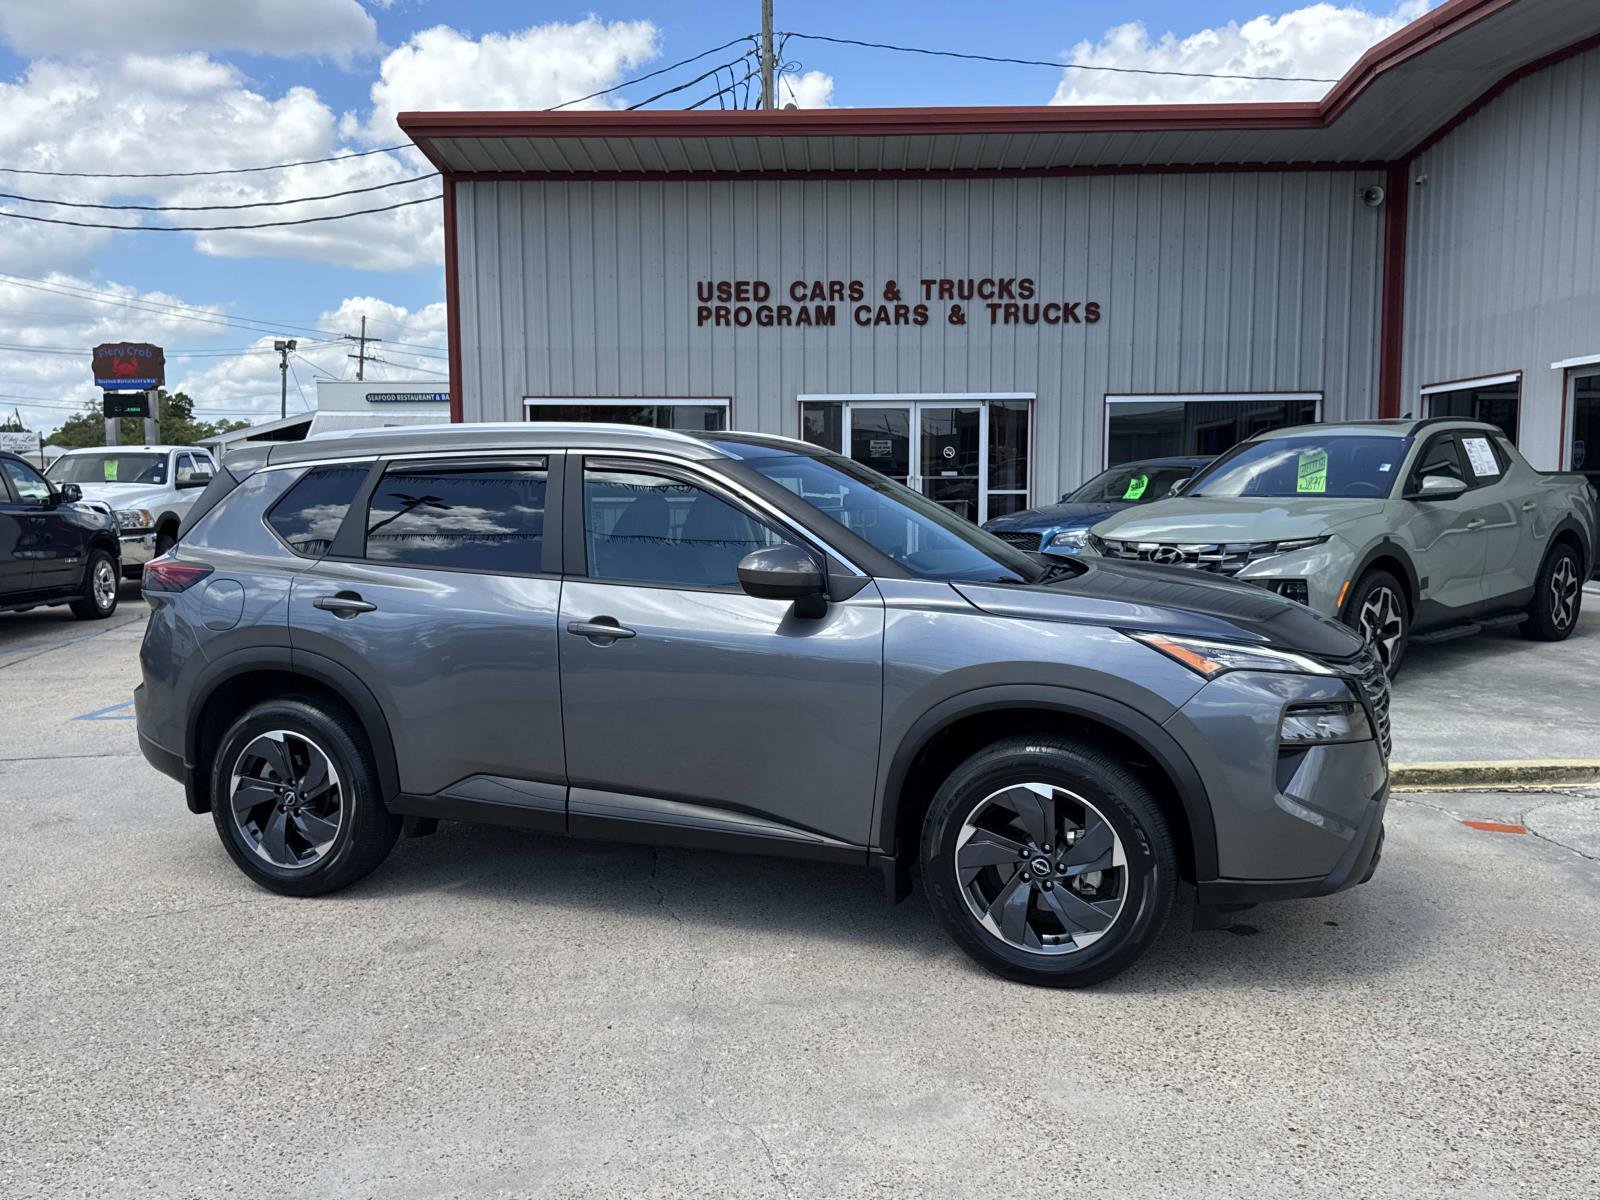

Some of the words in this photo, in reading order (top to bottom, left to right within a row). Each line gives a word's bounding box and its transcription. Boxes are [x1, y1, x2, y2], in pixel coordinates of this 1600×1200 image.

[696, 280, 770, 302] USED
[790, 280, 864, 302] CARS
[883, 280, 901, 302] &
[920, 278, 1035, 300] TRUCKS
[697, 305, 836, 326] PROGRAM
[854, 304, 929, 326] CARS
[947, 303, 967, 326] &
[986, 301, 1101, 325] TRUCKS
[126, 346, 153, 359] Crab
[1130, 480, 1145, 491] SALE
